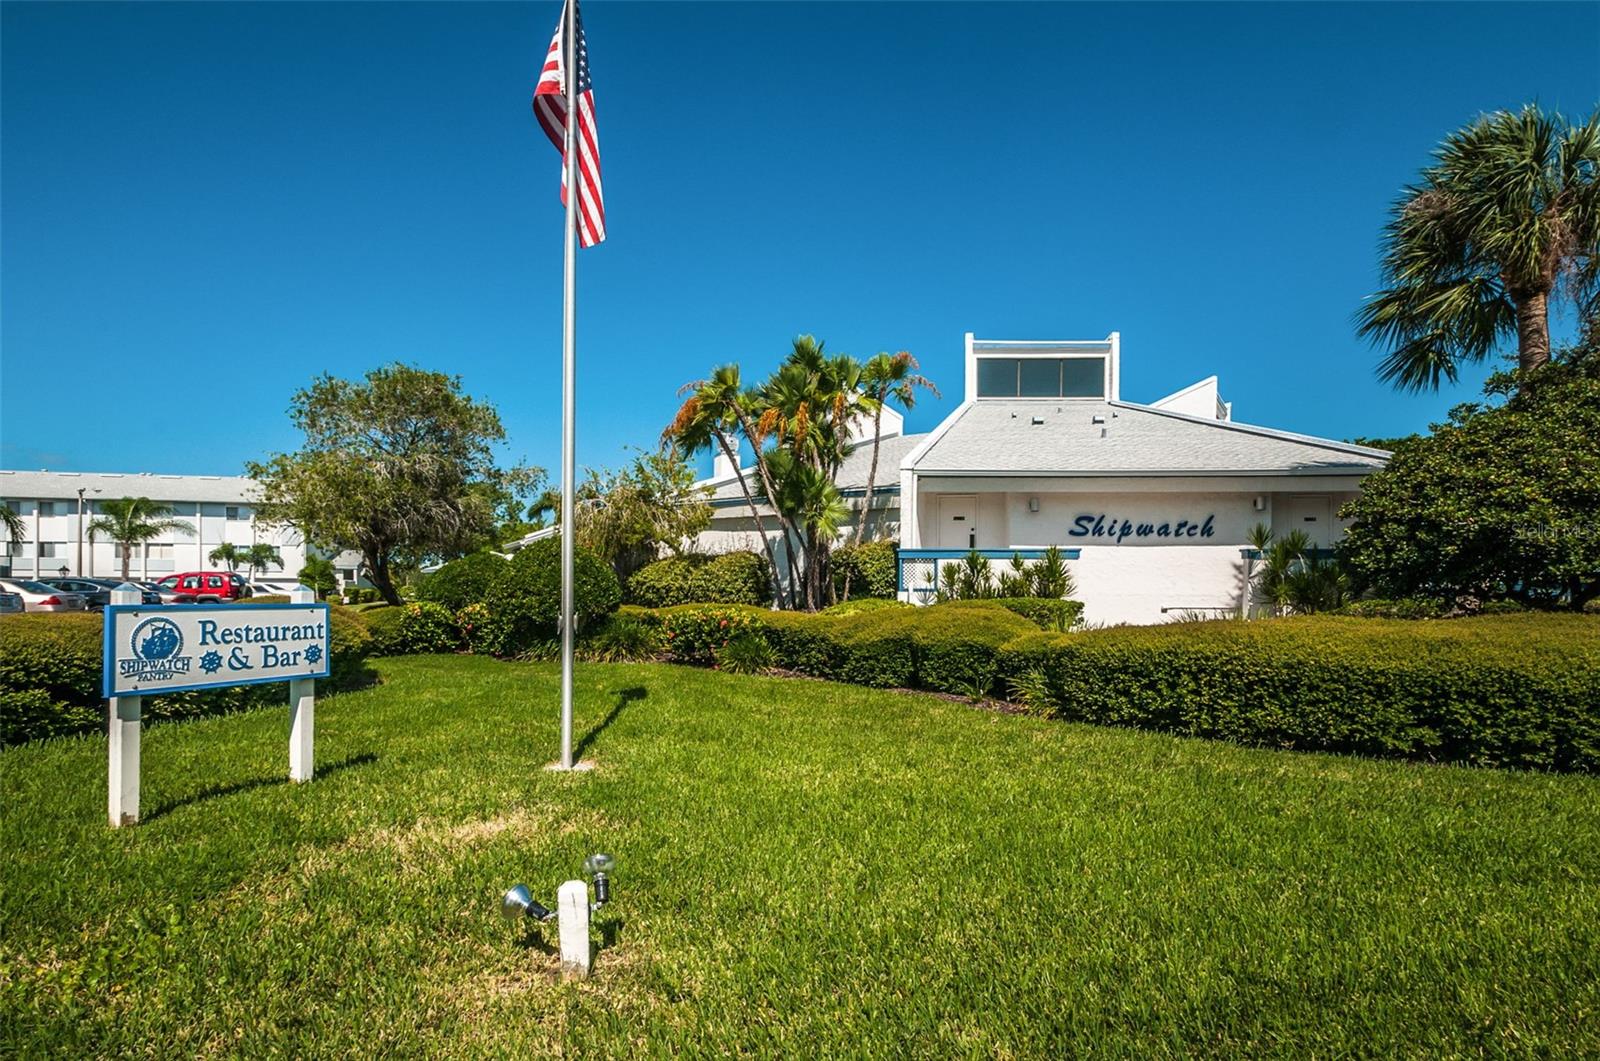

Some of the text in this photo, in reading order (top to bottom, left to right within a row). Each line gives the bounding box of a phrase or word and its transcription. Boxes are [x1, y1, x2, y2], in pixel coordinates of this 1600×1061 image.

[1068, 515, 1215, 543] Shipwatch
[198, 620, 324, 646] Restaurant
[227, 644, 301, 671] & Bar
[137, 672, 174, 682] PANTRY
